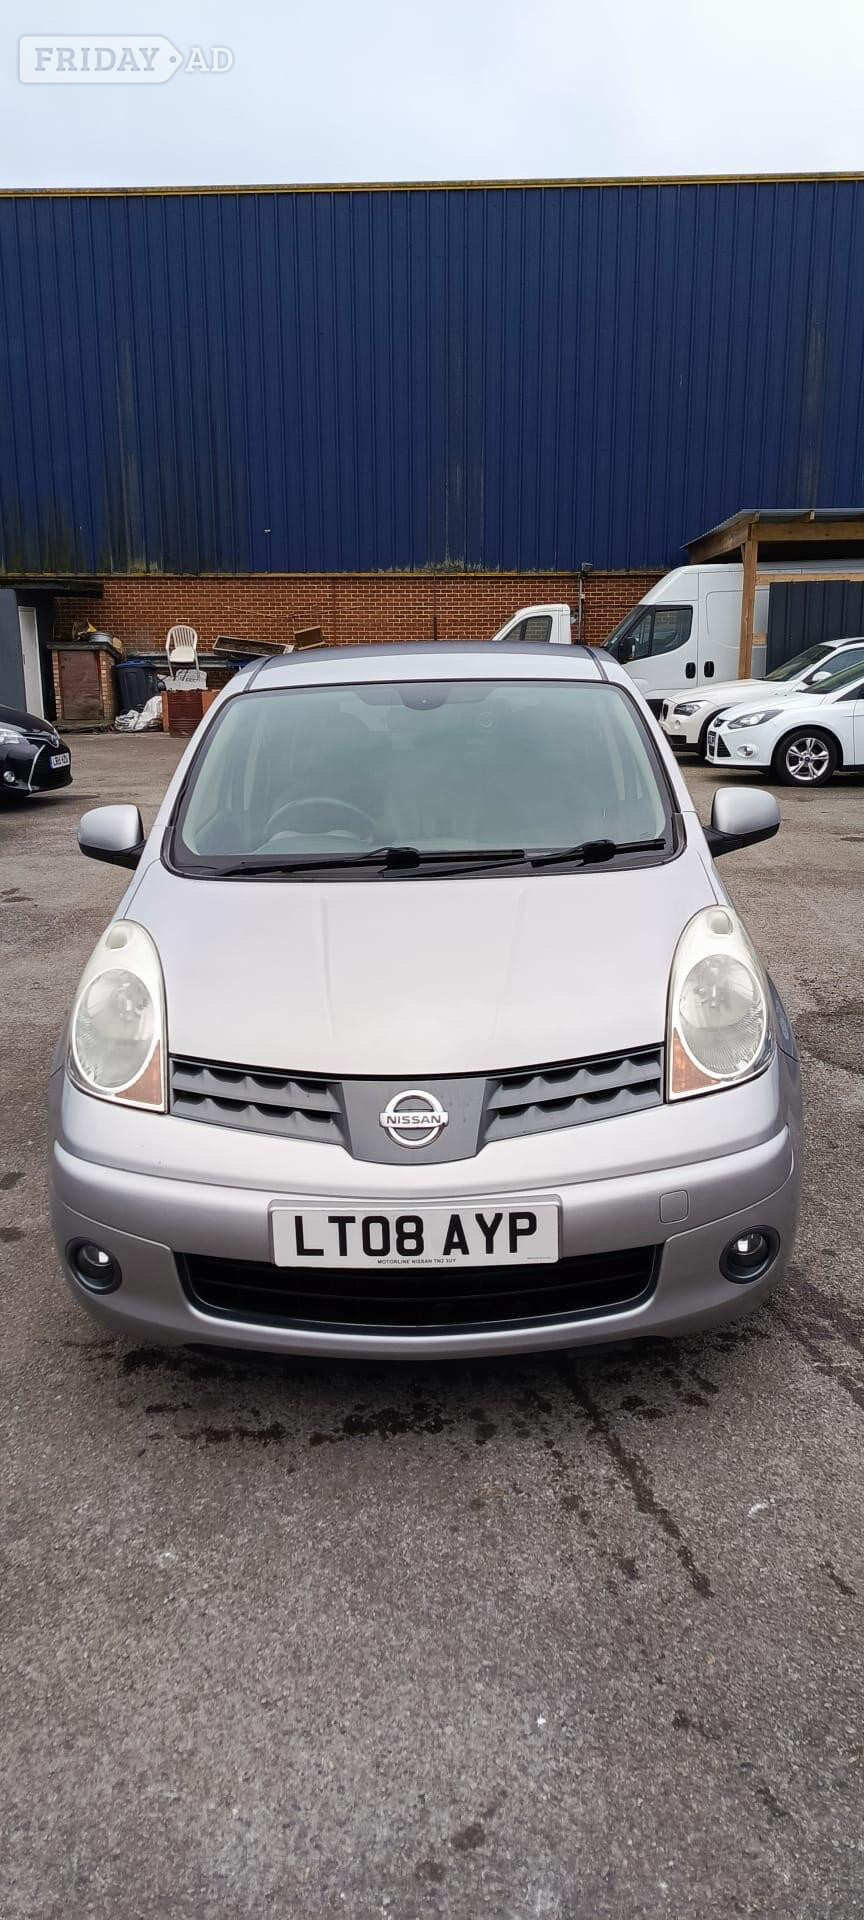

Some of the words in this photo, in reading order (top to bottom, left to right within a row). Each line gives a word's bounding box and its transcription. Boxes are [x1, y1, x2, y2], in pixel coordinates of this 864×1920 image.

[386, 1115, 442, 1125] NISSAN
[294, 1215, 425, 1257] LT08
[442, 1211, 538, 1256] AYP
